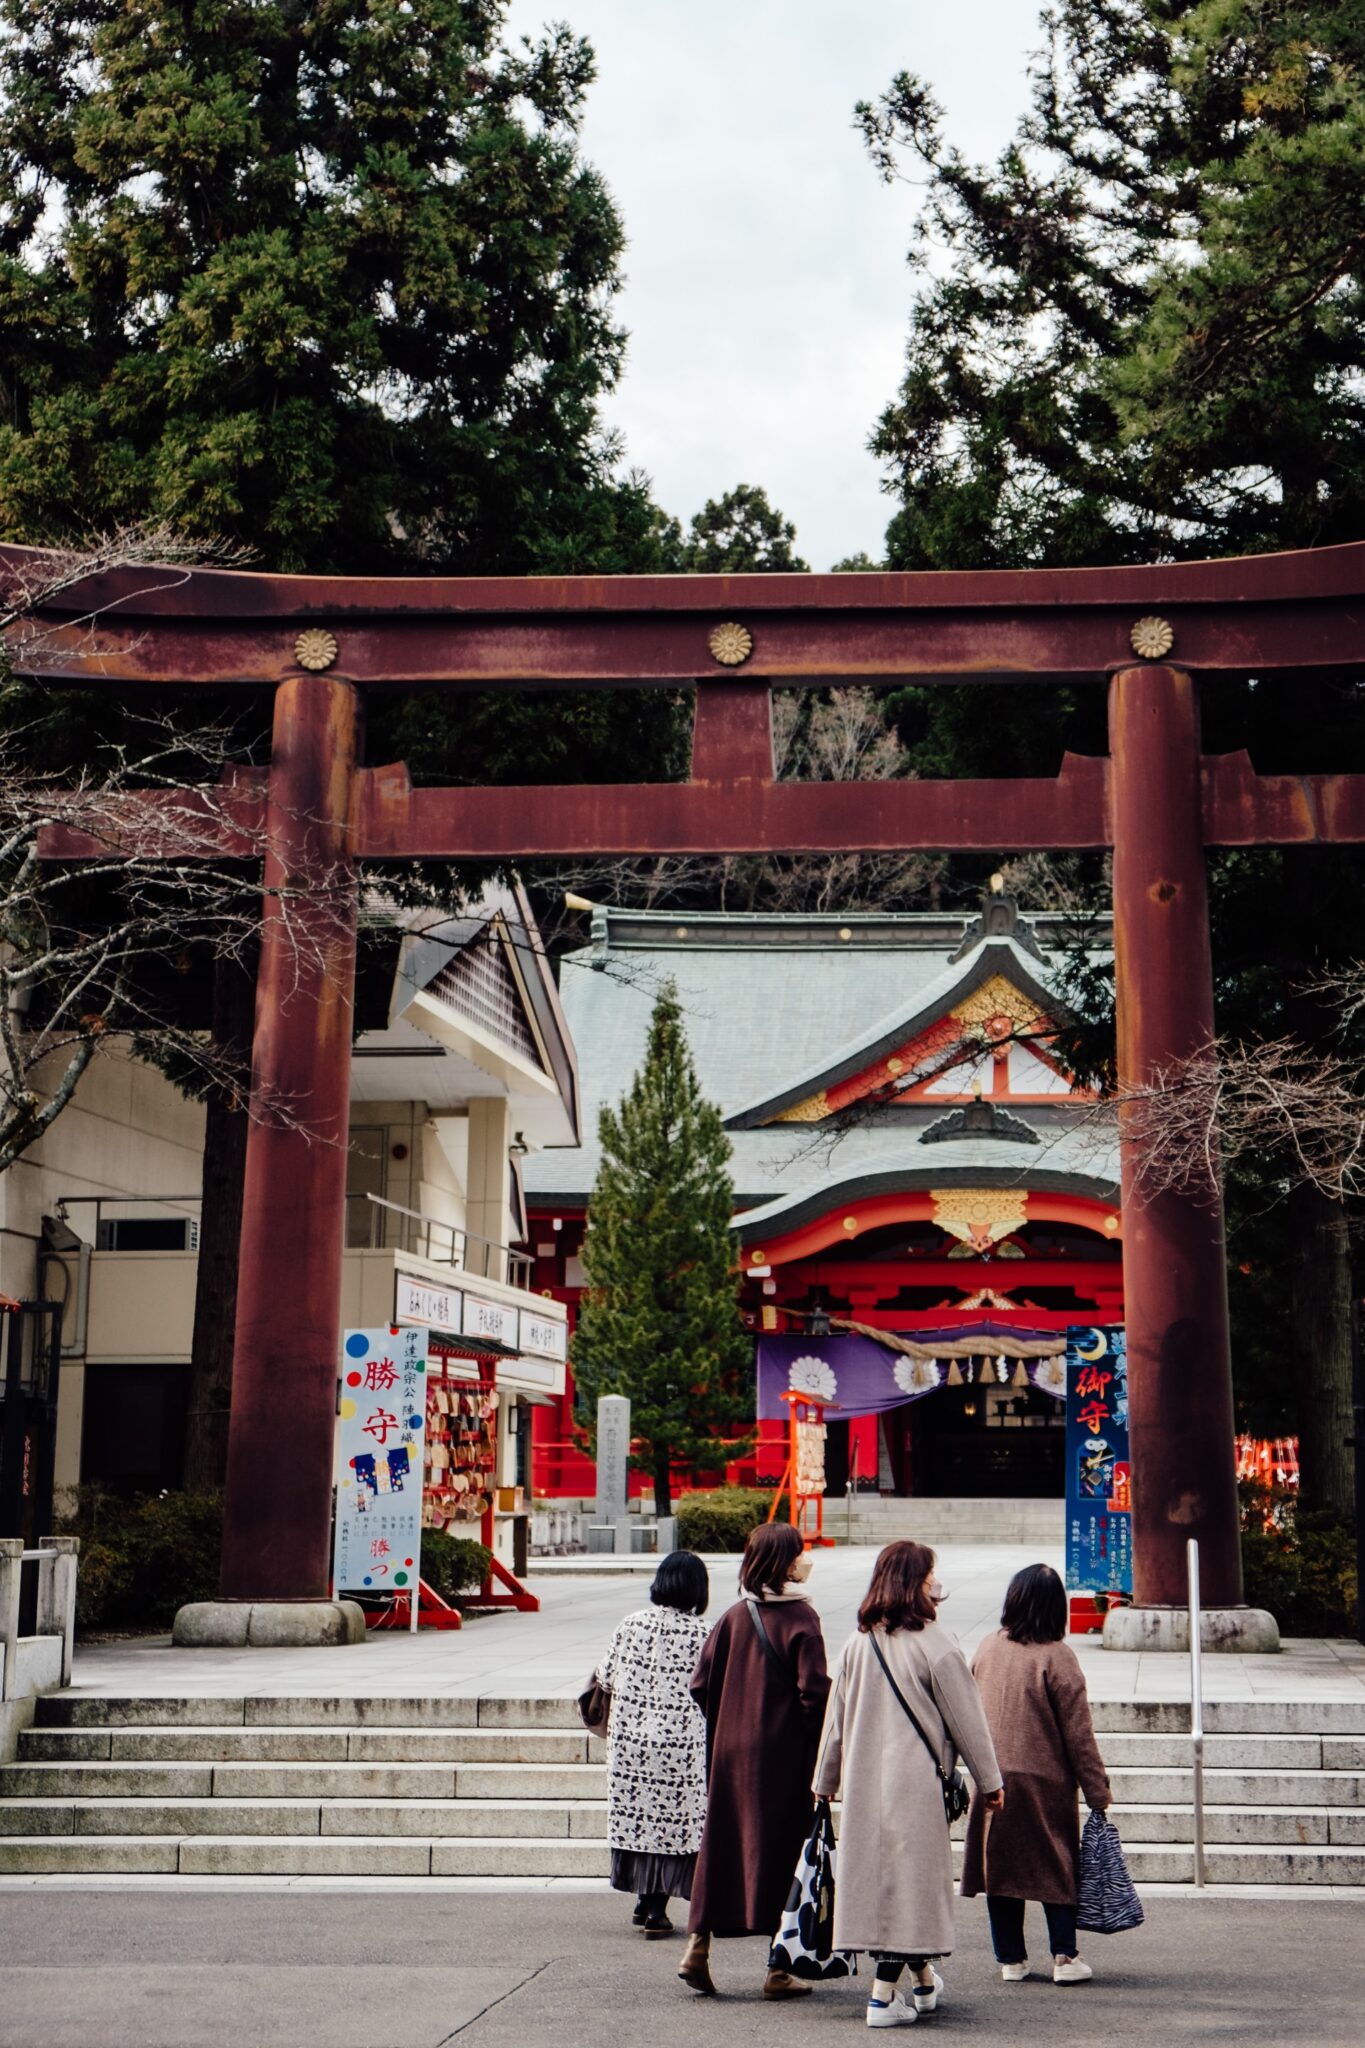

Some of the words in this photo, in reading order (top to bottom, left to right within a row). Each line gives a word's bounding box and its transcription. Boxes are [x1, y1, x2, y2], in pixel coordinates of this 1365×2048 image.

[404, 1331, 418, 1398] 伊達政宗公
[362, 1356, 400, 1445] 勝守
[1075, 1366, 1112, 1434] 御守
[370, 1537, 391, 1576] 勝つ
